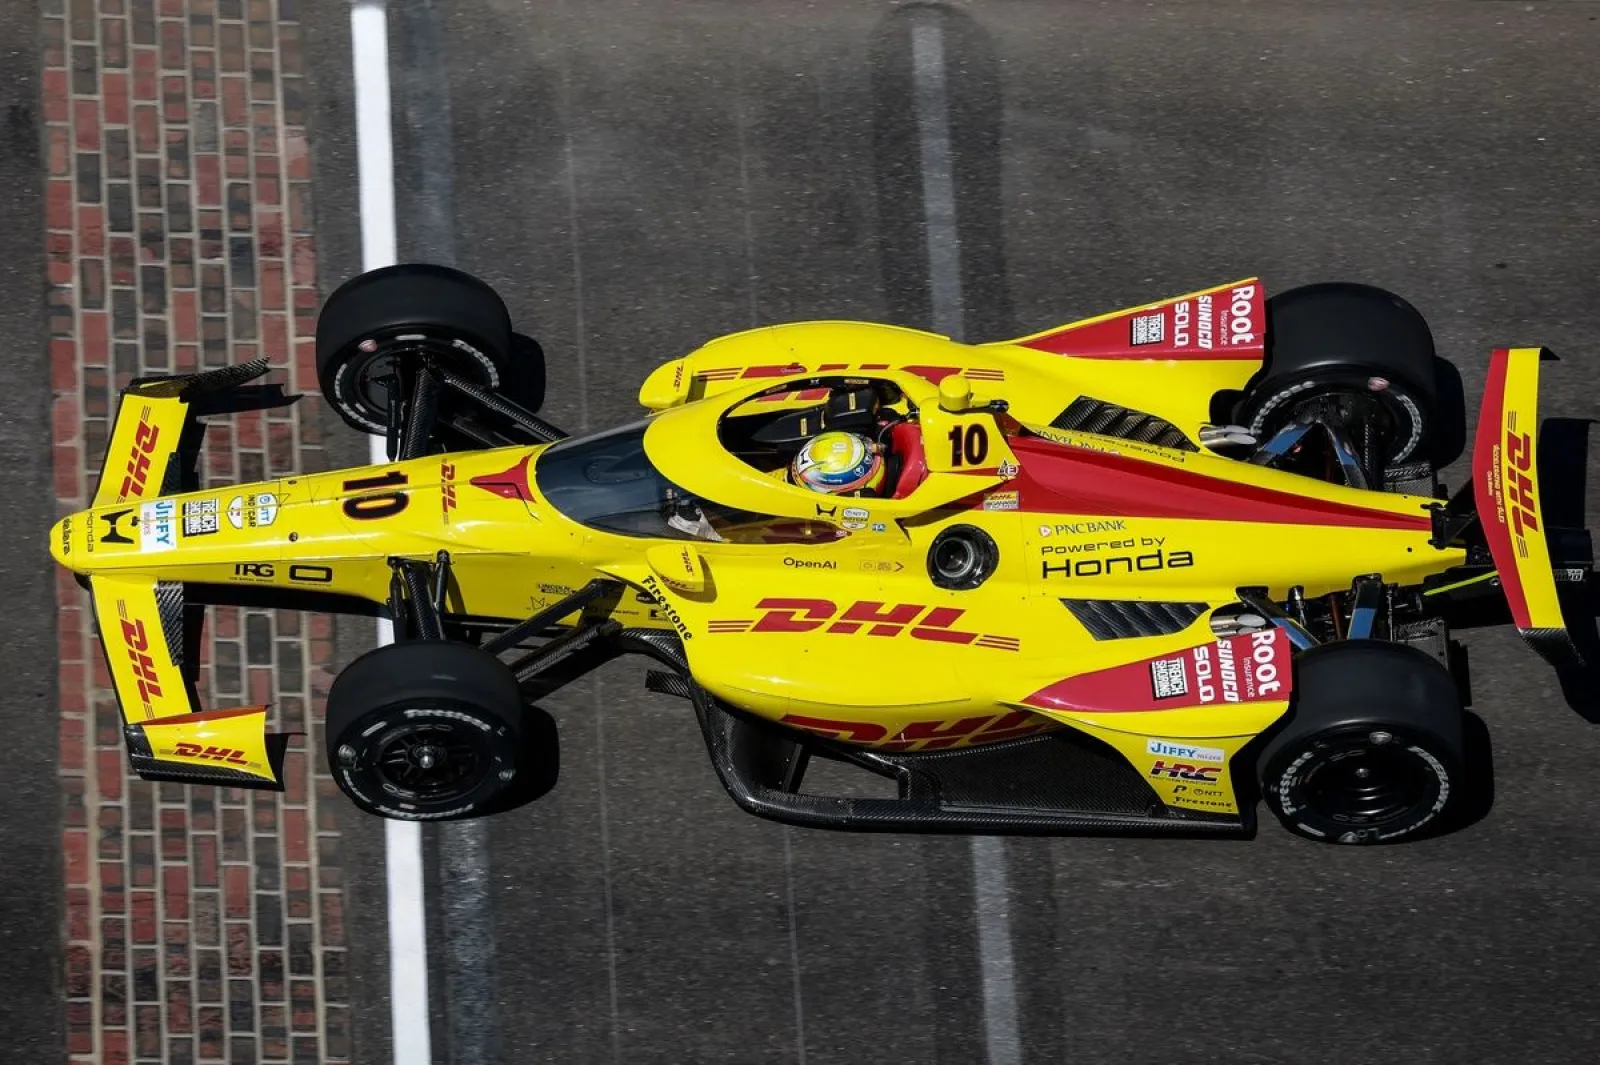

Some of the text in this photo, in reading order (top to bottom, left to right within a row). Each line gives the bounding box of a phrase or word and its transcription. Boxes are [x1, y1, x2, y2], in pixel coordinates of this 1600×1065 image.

[1174, 301, 1190, 346] SOLO
[1198, 296, 1212, 349] SUNOCO
[1232, 285, 1255, 345] Root
[120, 421, 159, 496] DHL
[948, 424, 988, 467] 10
[342, 472, 410, 520] 10
[442, 464, 456, 512] DHL
[1508, 432, 1538, 537] DHL
[1041, 537, 1166, 556] Powered by
[1055, 520, 1127, 536] PNC BANK
[783, 556, 837, 570] OpenAI
[1042, 550, 1194, 579] Honda
[642, 575, 692, 641] Firestone
[750, 598, 980, 644] DHL
[120, 618, 162, 704] DHL
[1168, 658, 1184, 695] TRENCH
[1193, 646, 1215, 702] SOLO
[1217, 638, 1240, 702] SUNOCO
[1244, 656, 1256, 698] Insurance
[1252, 630, 1280, 696] Root
[173, 743, 248, 764] DHL
[1151, 742, 1196, 758] JIFFY
[1151, 760, 1222, 782] HRC
[1176, 796, 1232, 808] Firestone
